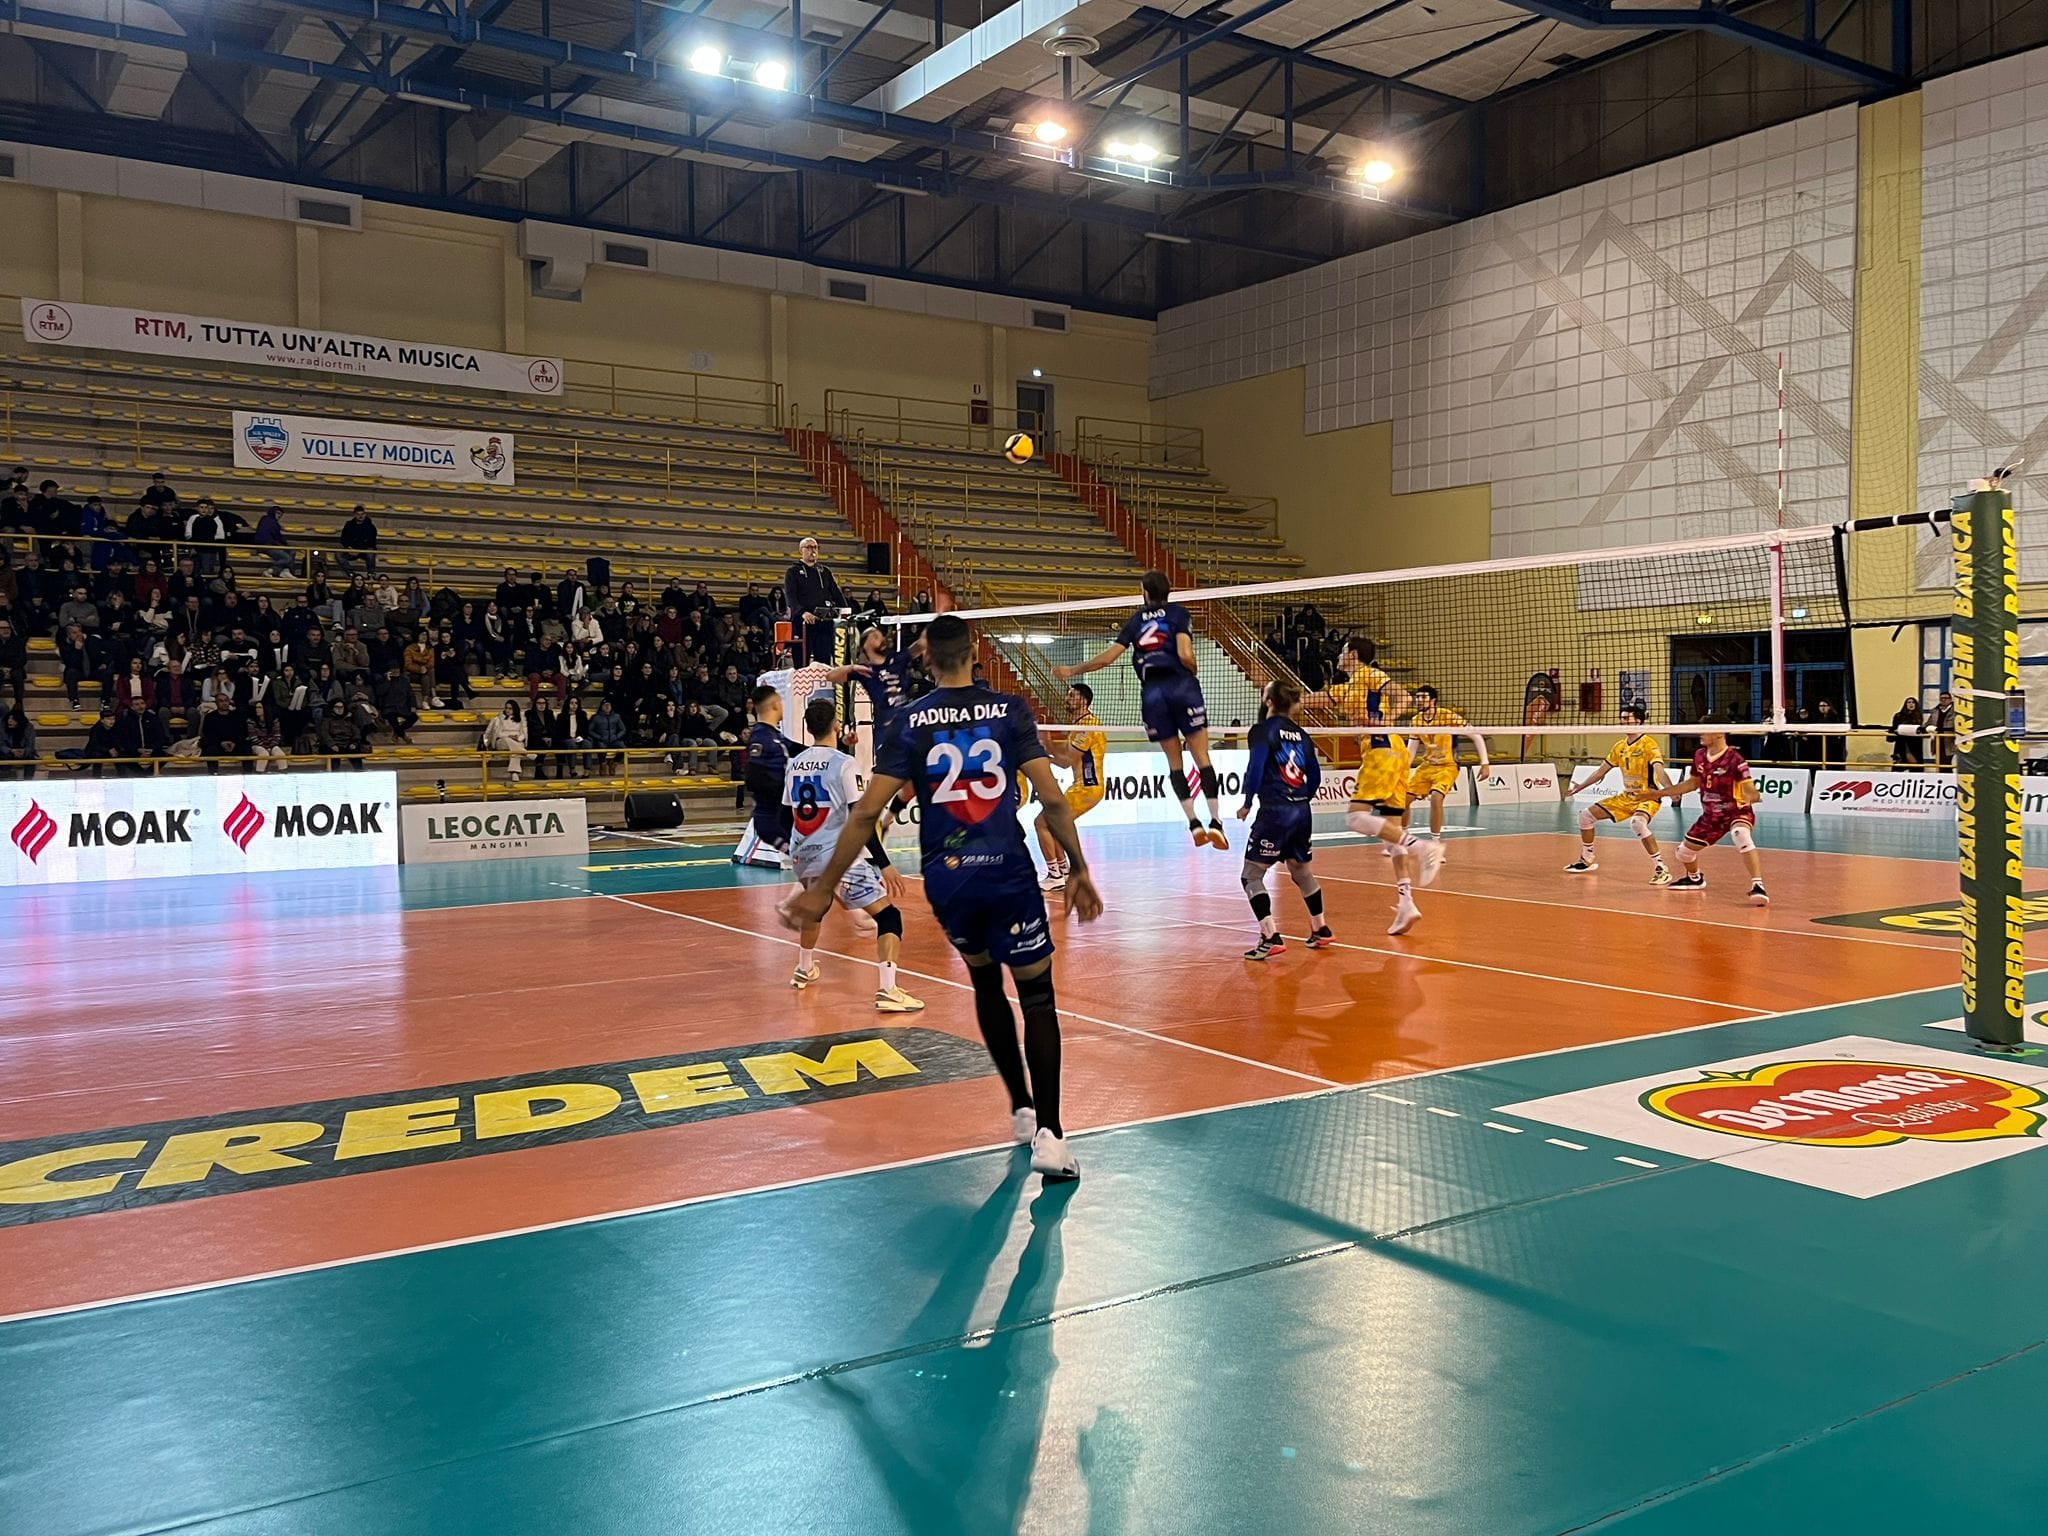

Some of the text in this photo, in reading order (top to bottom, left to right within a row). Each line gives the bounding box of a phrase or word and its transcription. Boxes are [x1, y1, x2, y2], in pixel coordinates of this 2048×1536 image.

[39, 320, 65, 332] RTM
[134, 317, 481, 372] RTM, TUTTA UN'ALTRA MUSICA
[266, 352, 367, 373] www.radiortm.it
[533, 374, 553, 384] RTM
[302, 437, 456, 466] VOLLEY MODICA
[1952, 511, 1973, 618] BANCA
[2002, 509, 2018, 617] BANCA
[833, 627, 846, 667] ANCA
[1139, 620, 1159, 647] 2
[1952, 632, 1974, 754] CREDEM
[2004, 630, 2021, 754] CDEM
[909, 703, 1009, 729] PADURA DIAZ
[791, 761, 830, 771] NASTASI
[926, 738, 1008, 804] 23
[797, 783, 818, 821] 8
[1104, 774, 1166, 801] MOAK
[1873, 778, 1958, 800] edilizia
[68, 808, 193, 848] MOAK
[273, 802, 383, 838] MOAK
[427, 812, 565, 840] LEOCATA
[1957, 774, 1976, 881] BANCA
[2004, 774, 2022, 881] BANCA
[470, 840, 529, 850] MANGIMI
[1960, 892, 1977, 1014] CREDEM
[2004, 895, 2024, 1019] CREDEM
[1697, 1070, 1969, 1130] Del Monte
[0, 1039, 921, 1206] CREDEM
